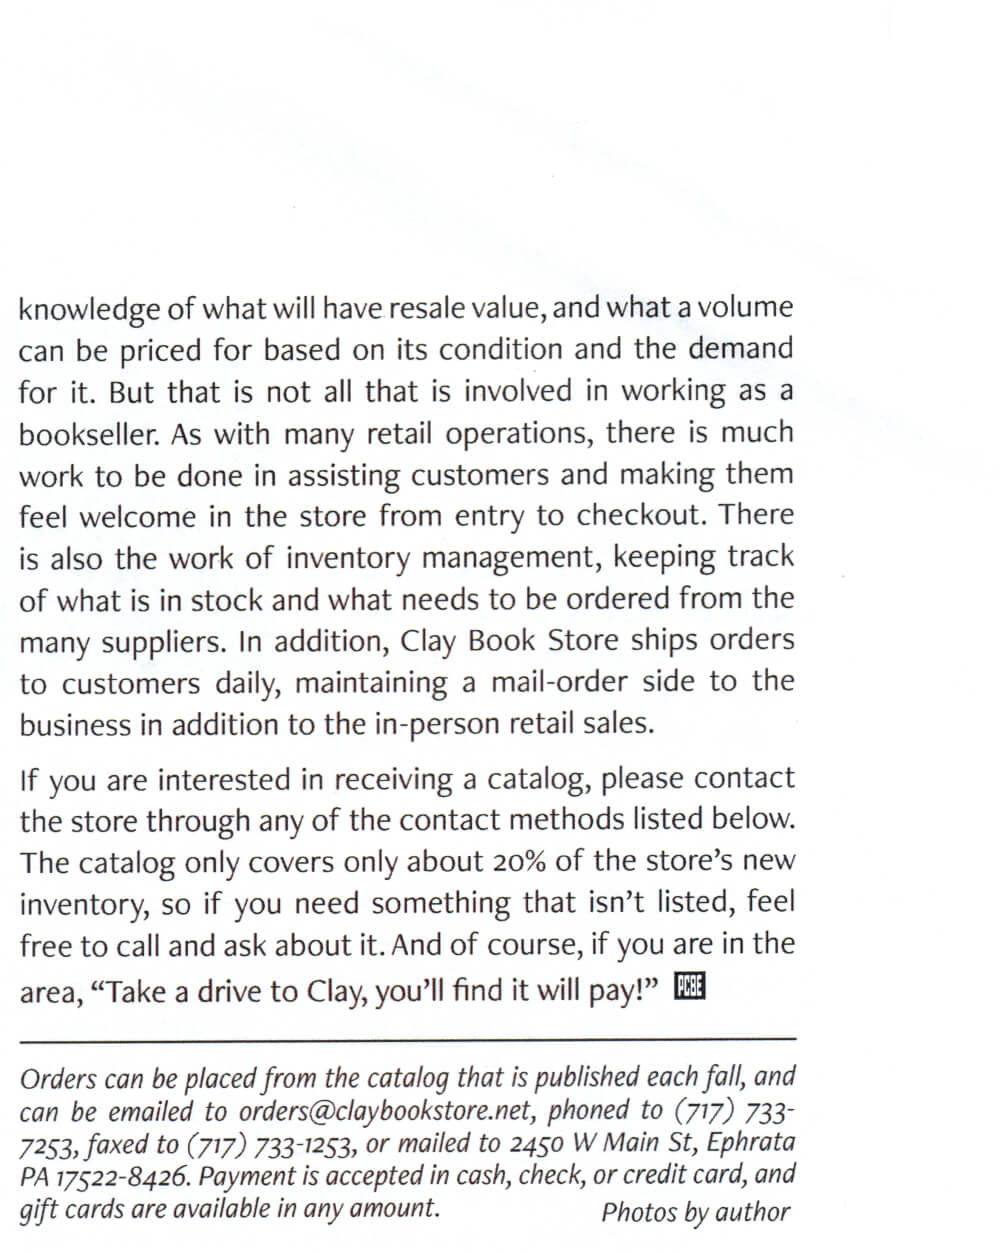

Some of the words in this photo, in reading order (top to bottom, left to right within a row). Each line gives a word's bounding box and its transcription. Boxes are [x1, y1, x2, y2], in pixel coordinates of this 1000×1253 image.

[20, 636, 91, 662] many
[102, 629, 227, 661] suppliers.
[240, 630, 262, 653] In
[274, 628, 389, 658] addition,
[400, 627, 457, 660] Clay
[469, 627, 535, 652] Book
[548, 628, 619, 651] Store
[631, 626, 698, 658] ships
[710, 626, 795, 651] orders
[20, 986, 83, 1009] area,
[175, 985, 189, 1003] a
[198, 978, 262, 1003] drive
[270, 980, 298, 1003] to
[307, 977, 368, 1010] Clay,
[453, 976, 502, 1002] find
[512, 977, 530, 1002] it
[537, 976, 580, 1001] will
[20, 1066, 97, 1090] Orders
[104, 1073, 144, 1090] can
[152, 1066, 178, 1089] be
[184, 1065, 257, 1096] placed
[260, 1065, 317, 1096] from
[325, 1065, 360, 1089] the
[367, 1065, 449, 1096] catalog
[457, 1065, 505, 1088] that
[511, 1065, 529, 1088] is
[534, 1064, 641, 1095] published
[647, 1064, 698, 1087] each
[701, 1063, 746, 1095] fall,
[754, 1063, 797, 1086] and
[19, 1106, 59, 1123] can
[71, 1100, 97, 1123] be
[108, 1099, 194, 1122] emailed
[205, 1101, 228, 1122] to
[239, 1098, 537, 1129] orders@claybookstore.net,
[547, 1097, 631, 1127] phoned
[641, 1100, 663, 1120] to
[675, 1096, 735, 1125] (717)
[745, 1102, 795, 1125] 733-
[19, 1138, 79, 1160] 7253,
[83, 1132, 150, 1162] faxed
[157, 1135, 180, 1154] to
[187, 1131, 247, 1160] (717)
[254, 1137, 358, 1160] 733-1253,
[366, 1137, 391, 1154] or
[398, 1131, 472, 1153] mailed
[479, 1133, 501, 1153] to
[509, 1136, 564, 1158] 2450
[574, 1132, 598, 1152] W
[603, 1131, 659, 1152] Main
[668, 1131, 698, 1157] St,
[707, 1129, 796, 1159] Ephrata
[20, 1166, 49, 1187] PA
[57, 1164, 191, 1193] 17522-8426.
[199, 1165, 297, 1194] Payment
[302, 1164, 320, 1186] is
[325, 1163, 425, 1193] accepted
[430, 1163, 450, 1185] in
[456, 1162, 512, 1190] cash,
[518, 1162, 586, 1190] check,
[593, 1168, 619, 1185] or
[623, 1162, 688, 1185] credit
[693, 1161, 748, 1189] card,
[754, 1161, 797, 1184] and
[19, 1197, 59, 1227] gift
[65, 1197, 125, 1219] cards
[131, 1203, 167, 1219] are
[173, 1196, 271, 1219] available
[277, 1197, 297, 1218] in
[303, 1202, 344, 1226] any
[349, 1198, 440, 1218] amount.
[601, 1200, 678, 1223] Photos
[684, 1200, 710, 1230] by
[715, 1199, 792, 1222] author
